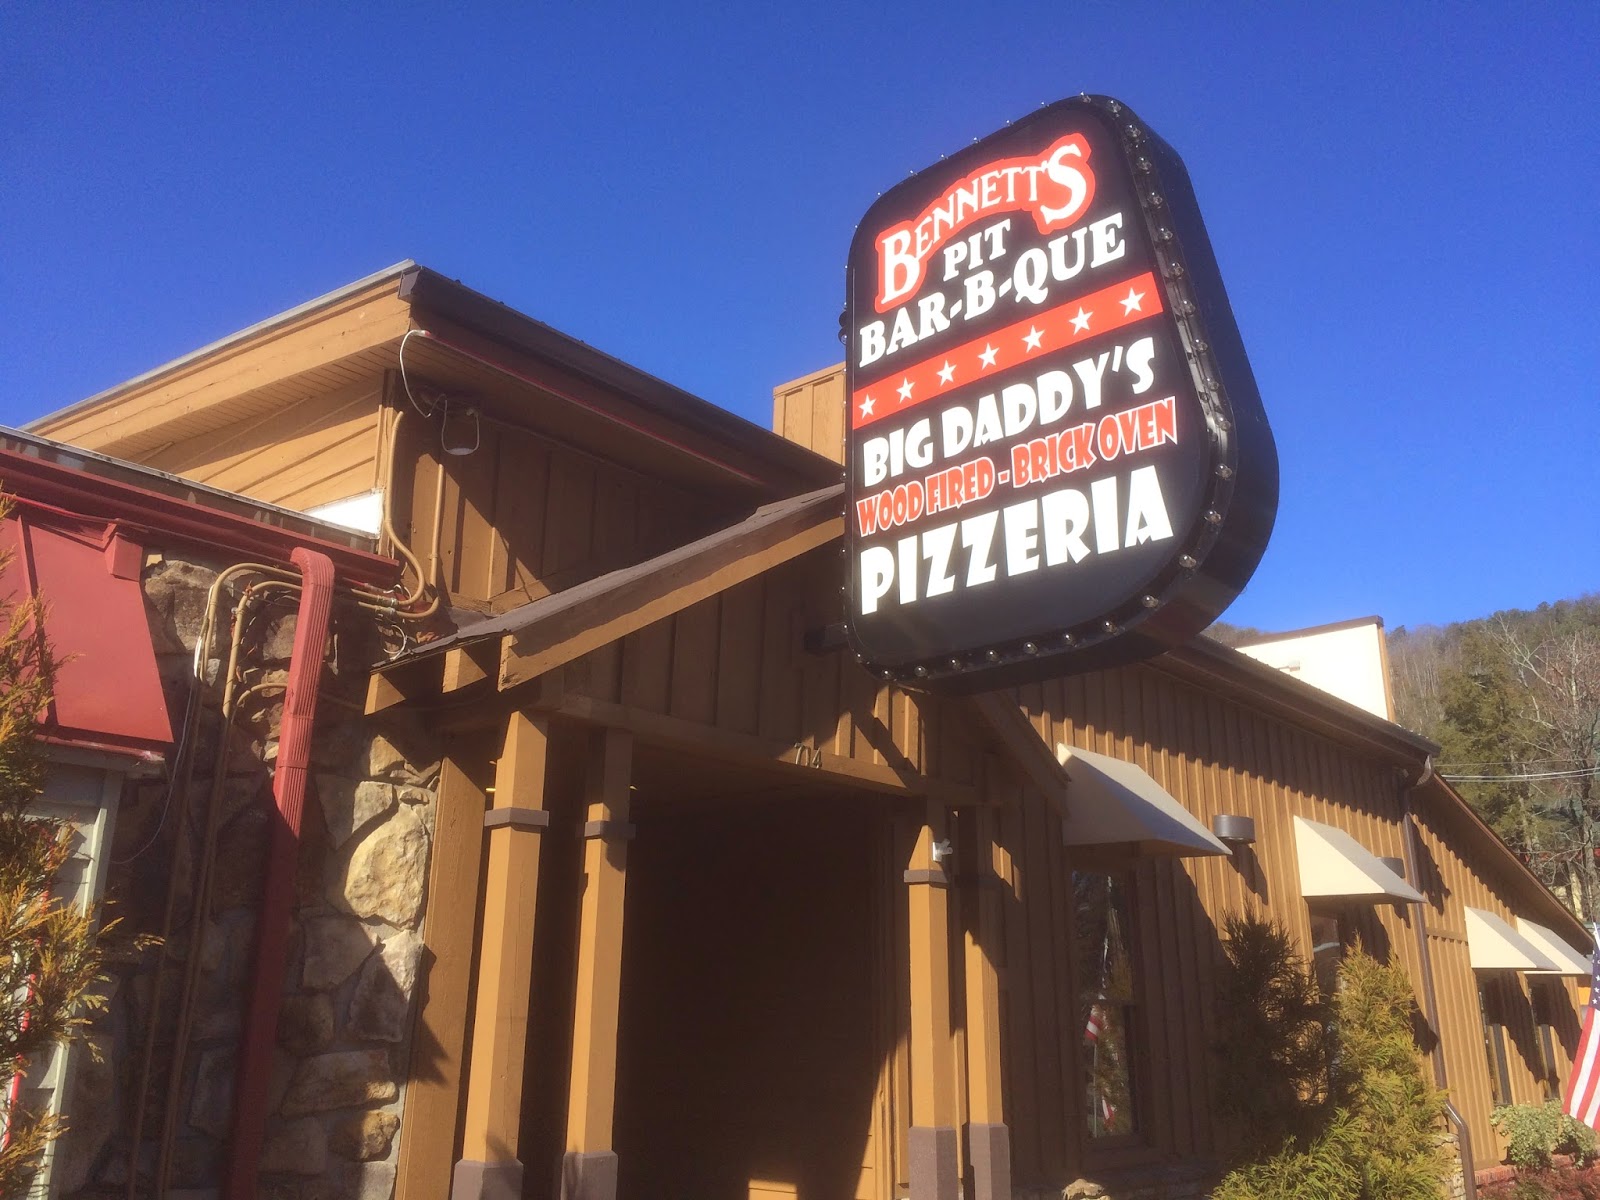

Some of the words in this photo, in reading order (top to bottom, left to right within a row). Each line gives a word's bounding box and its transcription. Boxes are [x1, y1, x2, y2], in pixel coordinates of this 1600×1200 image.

[859, 212, 1126, 368] BAR-B-QUE
[942, 218, 1011, 282] PIT
[856, 481, 924, 537] WOOD
[925, 456, 996, 516] FIRED
[1011, 422, 1097, 488] BRICK
[1097, 395, 1178, 461] OVEN
[863, 417, 934, 488] BIG
[941, 336, 1155, 458] DADDY'S
[860, 465, 1174, 616] PIZZERIA
